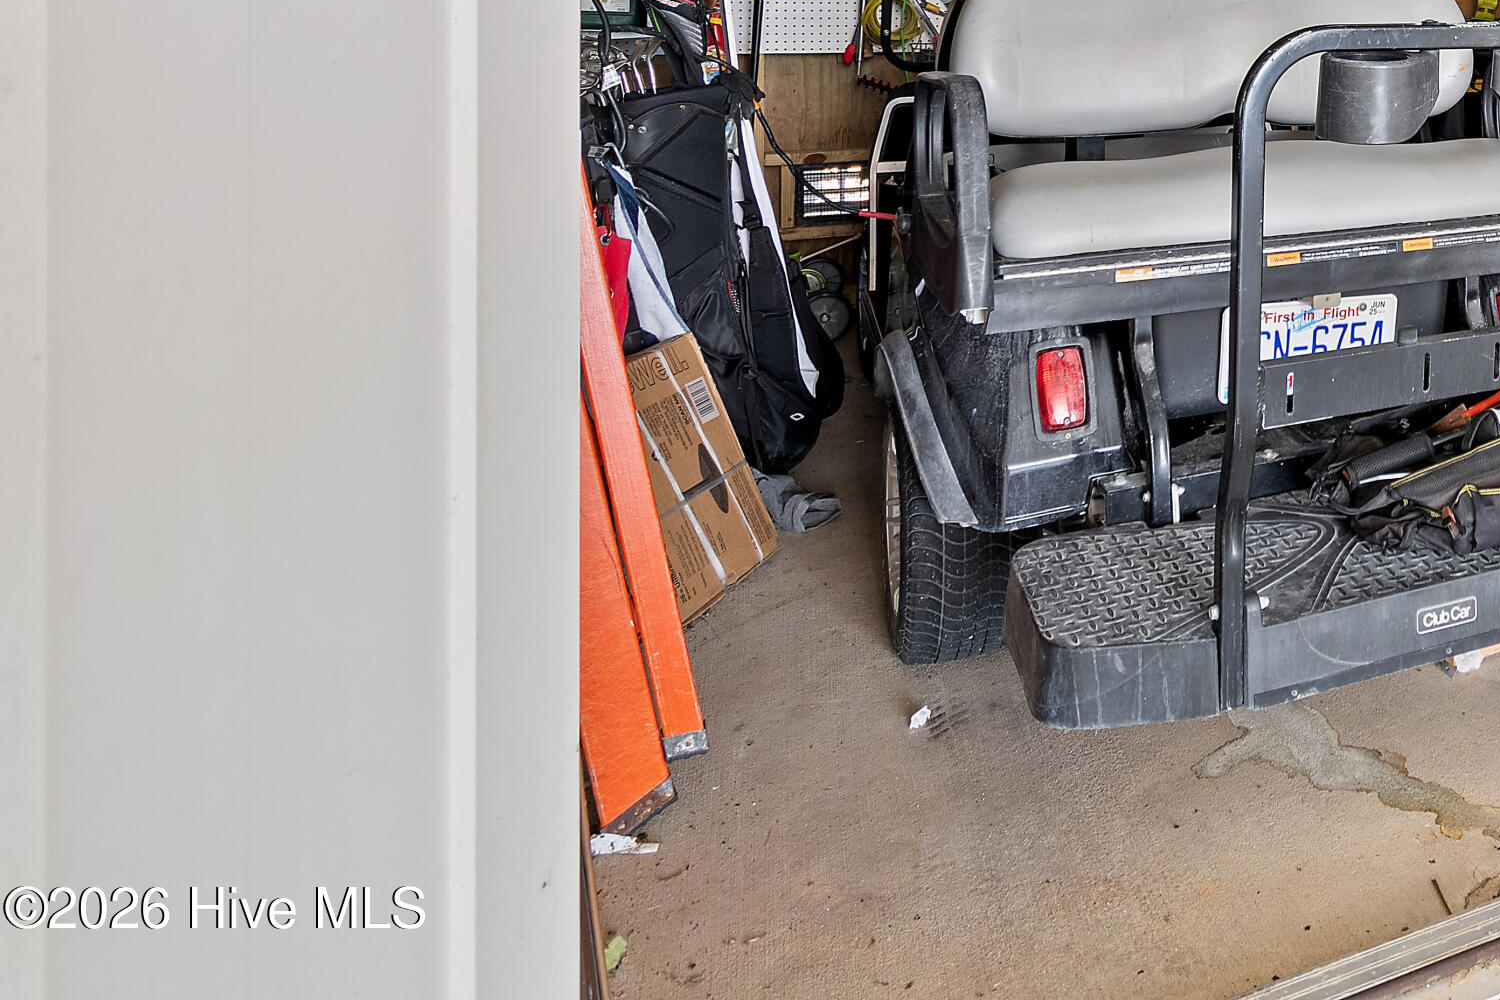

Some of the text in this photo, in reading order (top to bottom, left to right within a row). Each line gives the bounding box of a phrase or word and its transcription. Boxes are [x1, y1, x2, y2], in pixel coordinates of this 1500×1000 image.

[1265, 306, 1361, 324] First in Flight
[1422, 605, 1471, 627] Club Car
